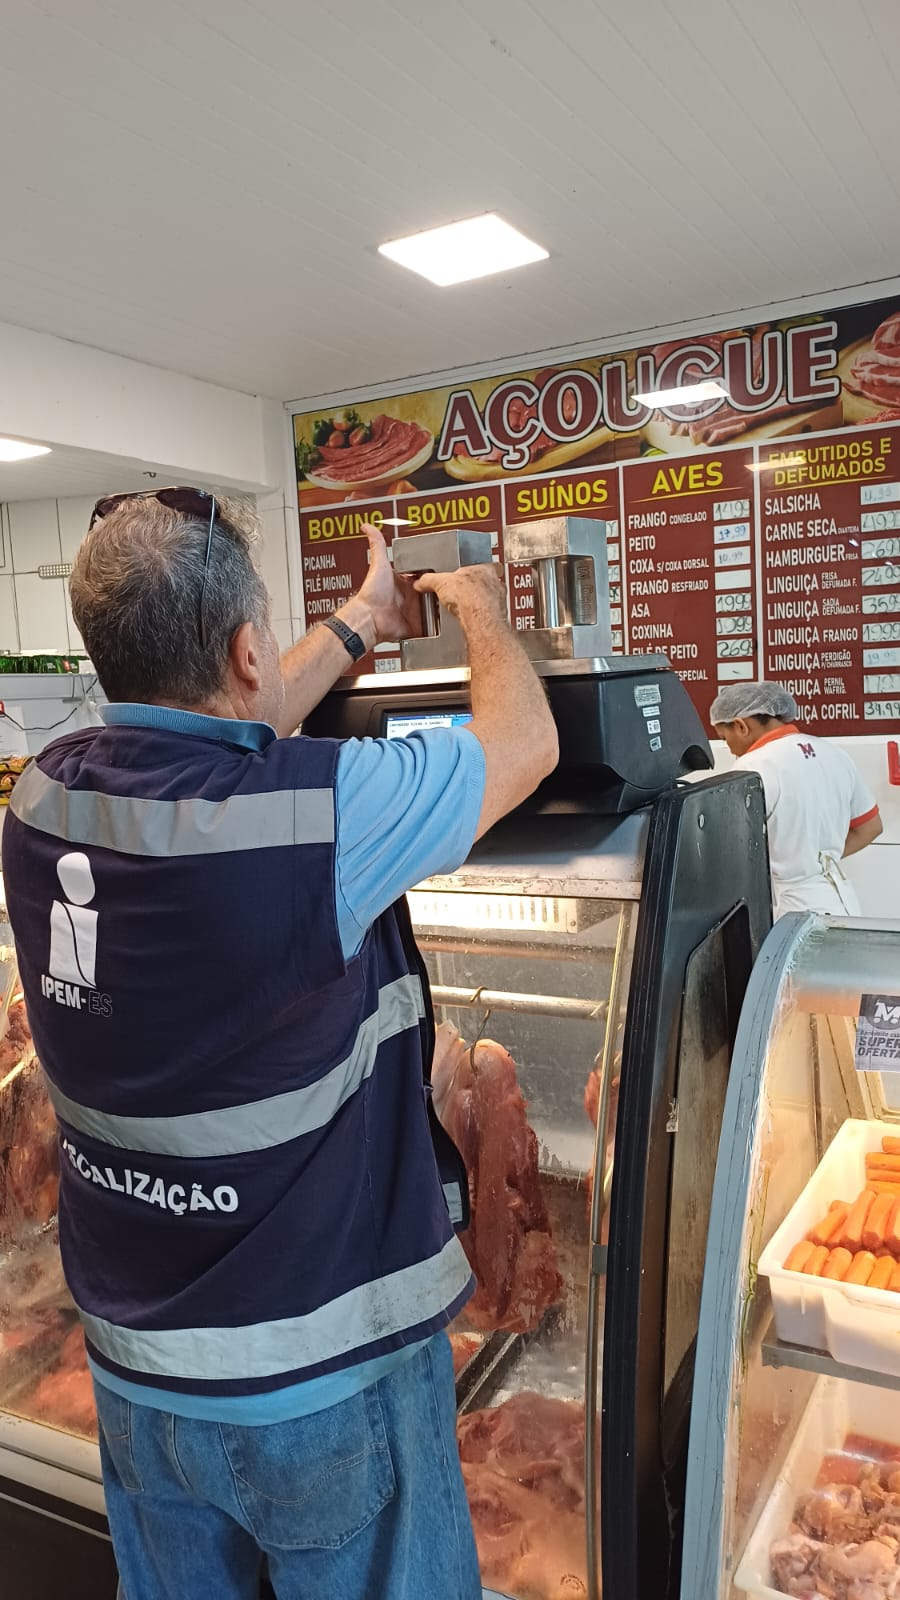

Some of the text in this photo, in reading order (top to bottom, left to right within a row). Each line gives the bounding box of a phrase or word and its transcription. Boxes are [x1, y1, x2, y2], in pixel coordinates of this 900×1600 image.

[437, 321, 841, 470] AÇOUGUE
[769, 437, 891, 465] EMBUTIDOS E
[652, 461, 723, 494] AVES
[774, 457, 886, 485] DEFUMADOS
[517, 480, 608, 512] SUÍNOS
[765, 492, 821, 515] SALSICHA
[407, 496, 490, 527] BOVINO
[628, 511, 667, 530] FRANGO
[669, 511, 707, 525] CONGELADO
[308, 511, 383, 540] BOVINO
[765, 521, 804, 542] CARNE
[807, 517, 838, 538] SECA
[629, 535, 656, 552] PEITO
[304, 553, 336, 571] PICANHA
[766, 544, 846, 568] HAMBURGUER
[629, 559, 655, 574] COXA
[665, 560, 682, 572] COXA
[683, 557, 710, 570] DORSAL
[305, 574, 352, 592] FILÉ MIGNON
[514, 574, 534, 588] CAR
[767, 574, 819, 595] LINGUIÇA
[821, 572, 838, 580] FRISA
[821, 579, 852, 590] DEFUMADA
[630, 579, 669, 596] FRANGO
[671, 580, 709, 593] RESFRIADO
[307, 598, 337, 614] CONTRA
[515, 595, 534, 610] LOM
[631, 603, 651, 619] ASA
[767, 599, 819, 621] LINGUIÇA
[822, 598, 840, 606] SADIA
[822, 605, 855, 616] DEFUMADA
[516, 616, 535, 630] BIFE
[631, 623, 673, 640] COXINHA
[768, 626, 858, 648] LINGUIÇA FRANGO
[670, 644, 698, 660] PEITO
[821, 649, 851, 661] PERDIGÃO
[768, 652, 821, 673] LINGUIÇA
[674, 669, 708, 681] SPECIAL
[824, 677, 845, 686] PERNIL
[776, 678, 821, 700] NGUIÇA
[795, 703, 859, 724] UIÇA COFRIL
[41, 974, 114, 1018] IPEM-ES
[62, 1138, 239, 1215] SCALIZAÇÃO
